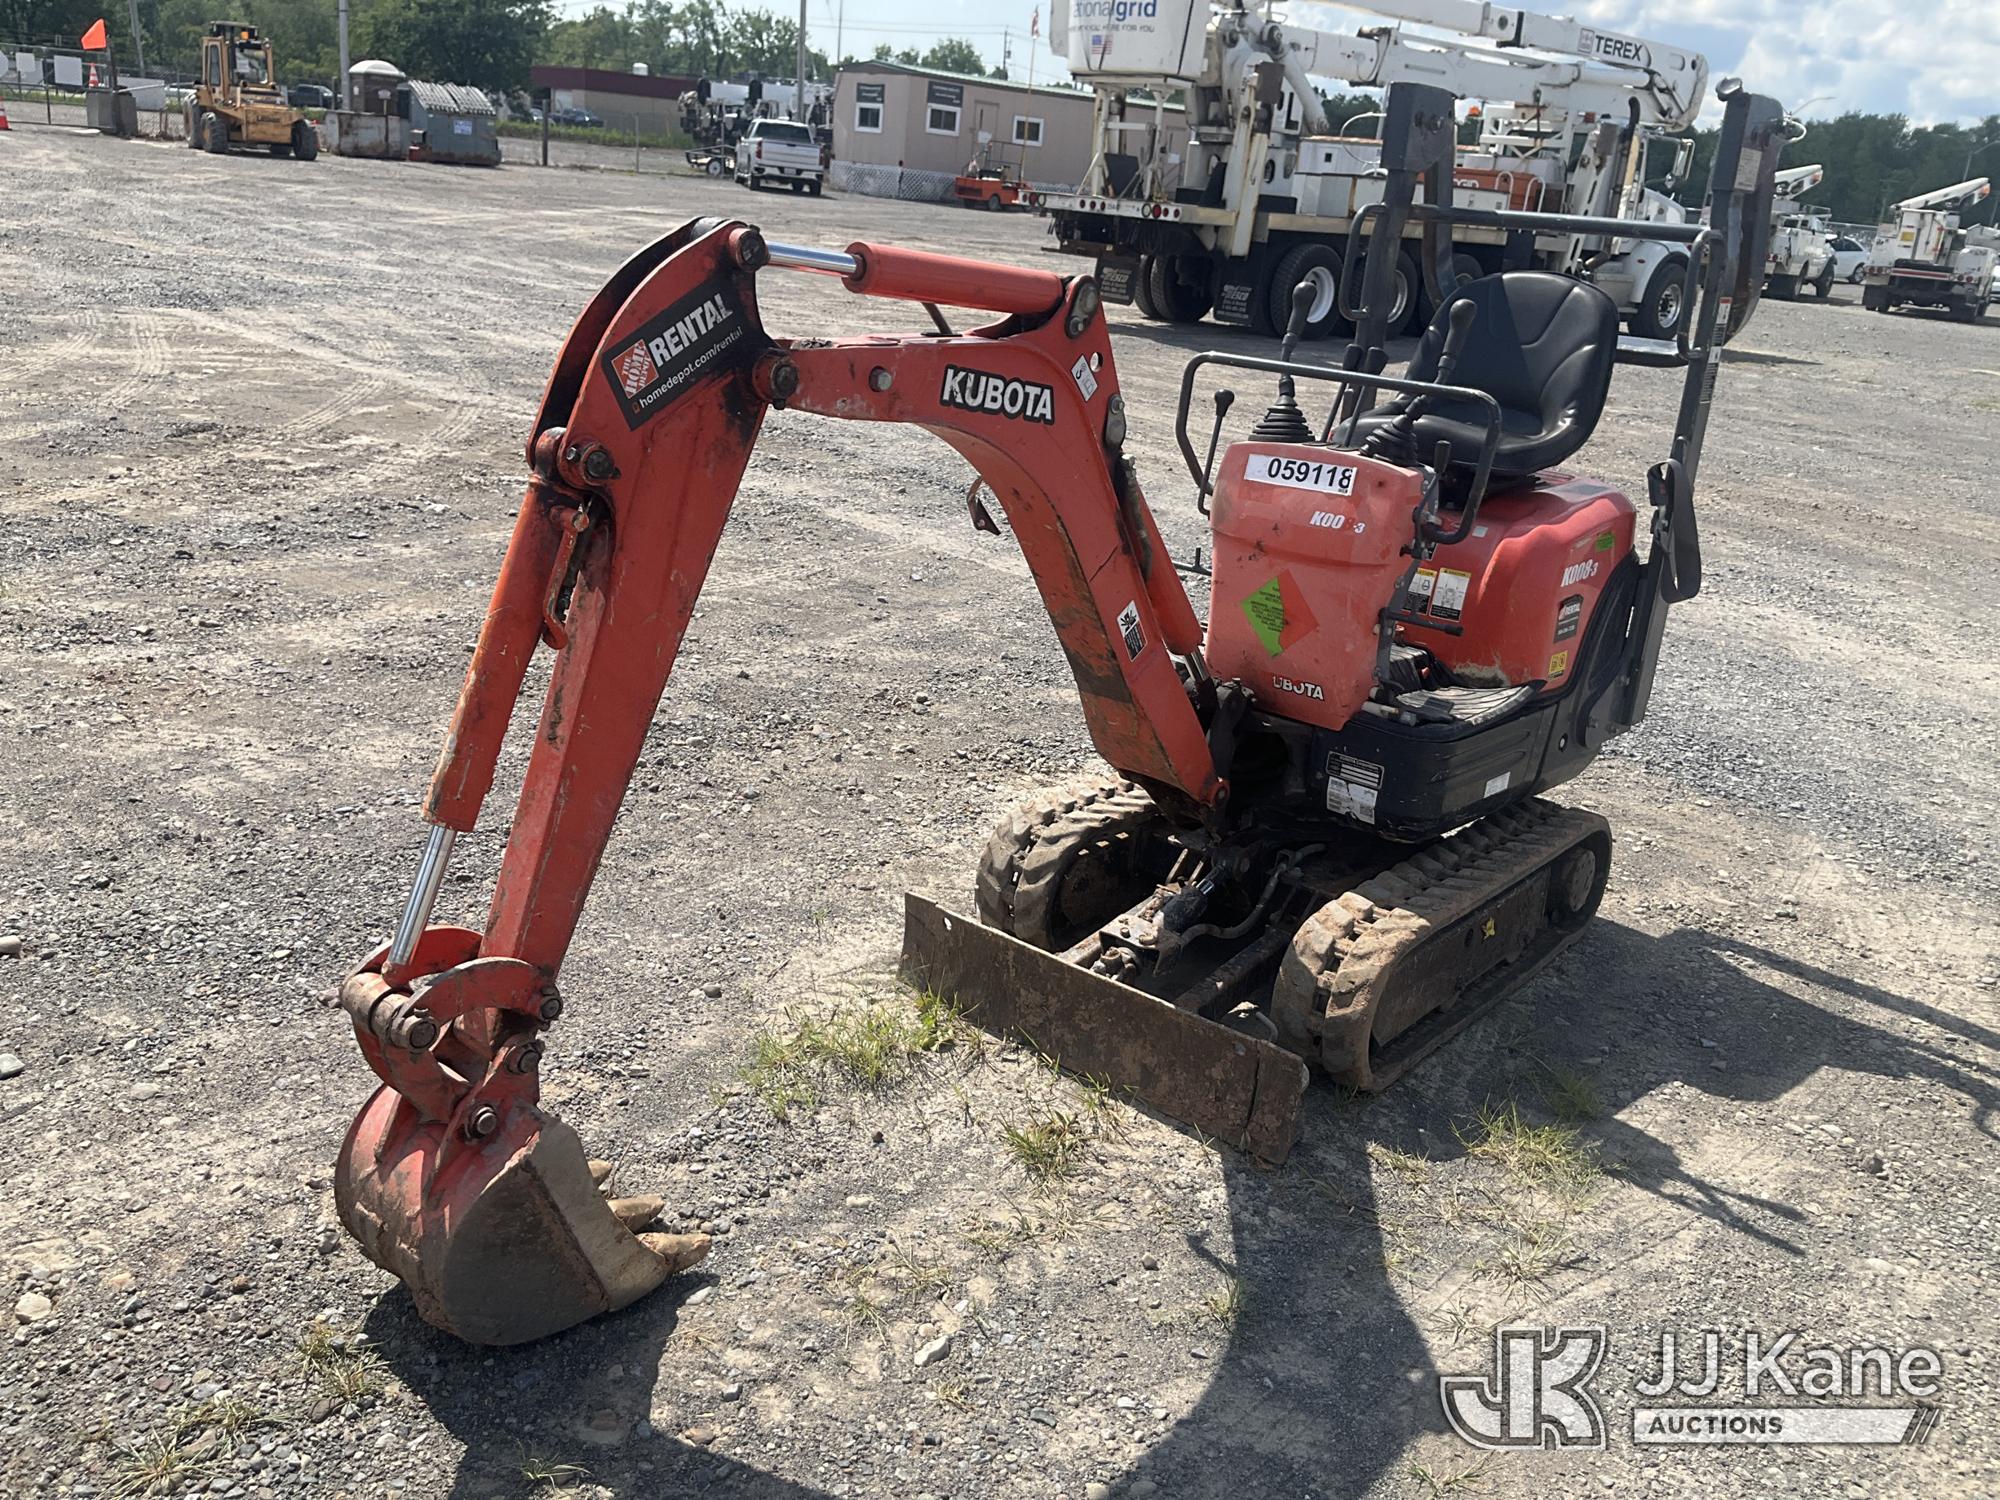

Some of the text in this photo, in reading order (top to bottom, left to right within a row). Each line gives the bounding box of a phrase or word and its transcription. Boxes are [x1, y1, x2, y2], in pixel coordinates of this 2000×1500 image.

[1595, 35, 1642, 61] TEREX
[648, 293, 733, 368] RENTAL
[639, 325, 743, 408] homedepot.com/rental
[942, 368, 1053, 421] KUBOTA
[1266, 457, 1353, 489] 059118
